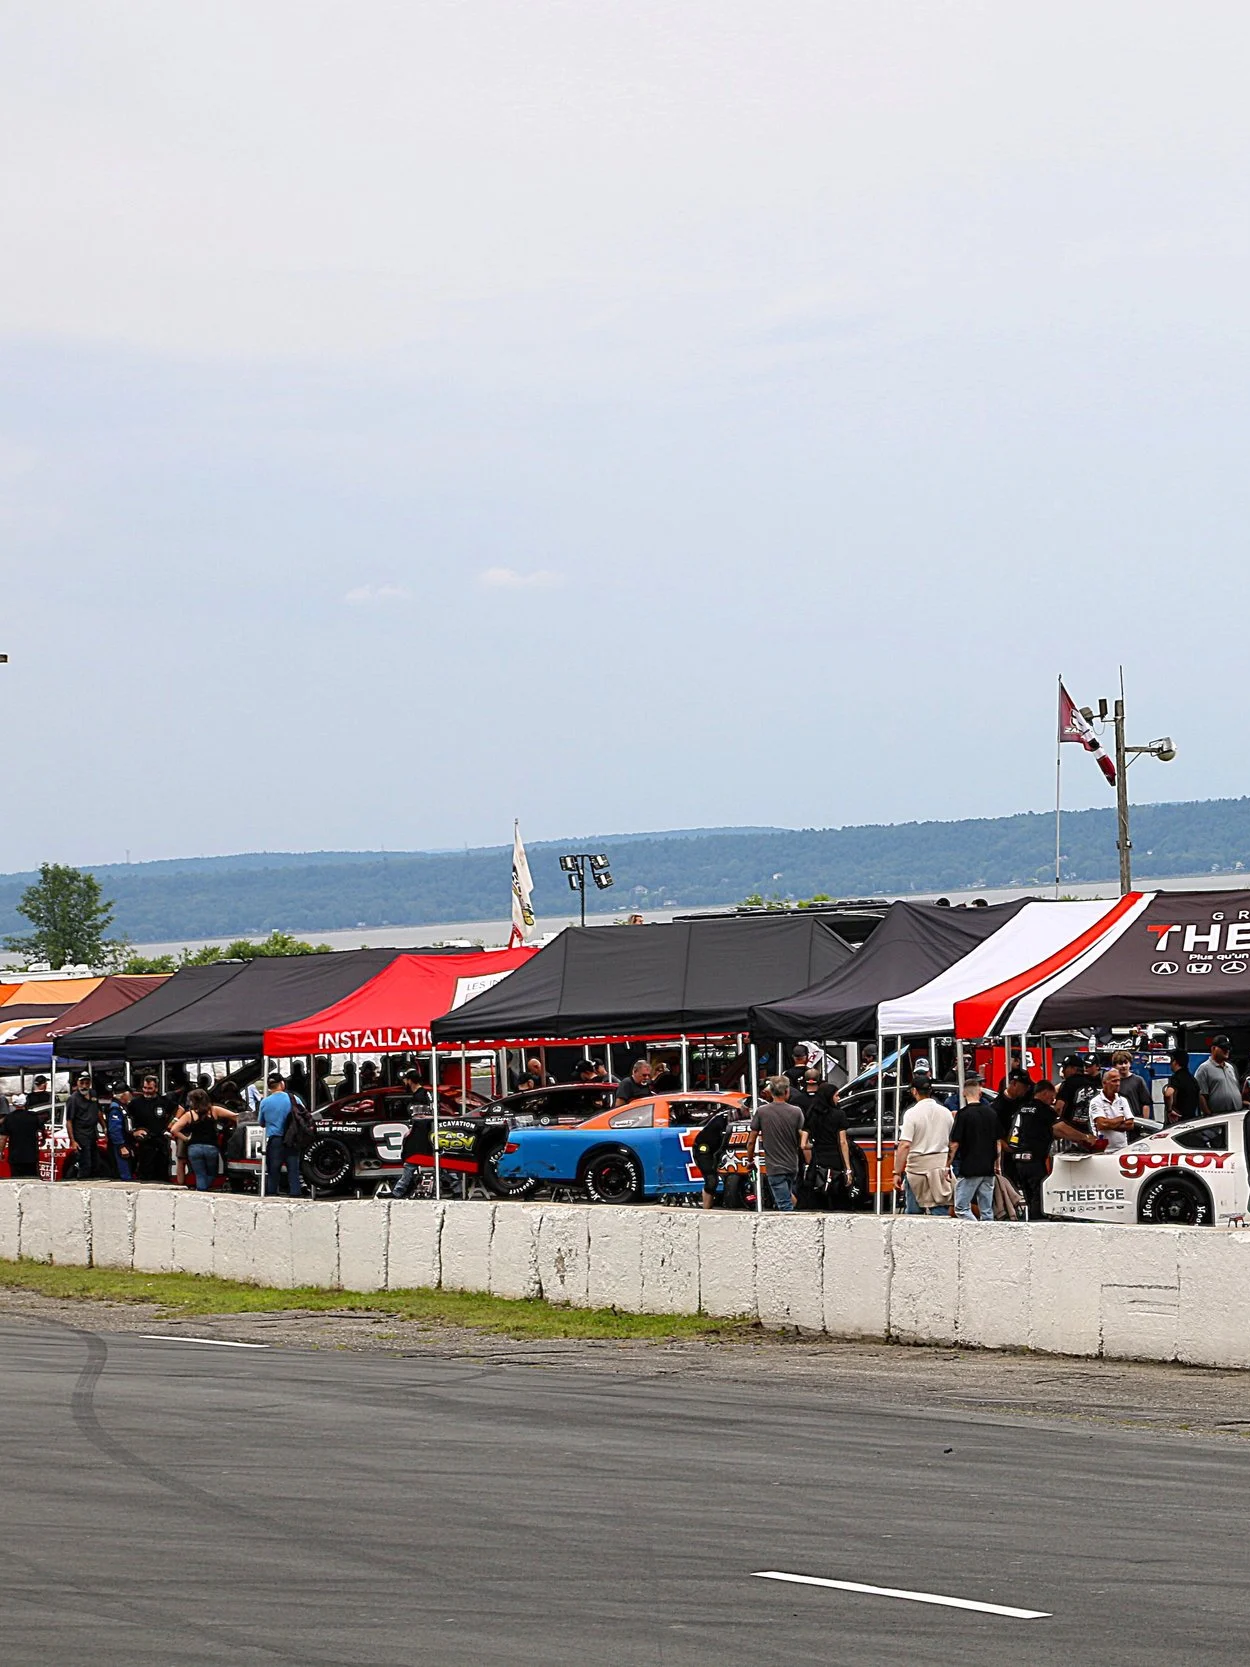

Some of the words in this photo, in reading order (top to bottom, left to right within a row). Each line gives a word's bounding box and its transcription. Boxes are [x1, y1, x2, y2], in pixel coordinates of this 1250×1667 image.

[319, 1029, 440, 1049] INSTALLATI
[438, 1120, 476, 1129] XCAVATION
[372, 1123, 409, 1160] 3
[1053, 1188, 1125, 1202] THEETGE
